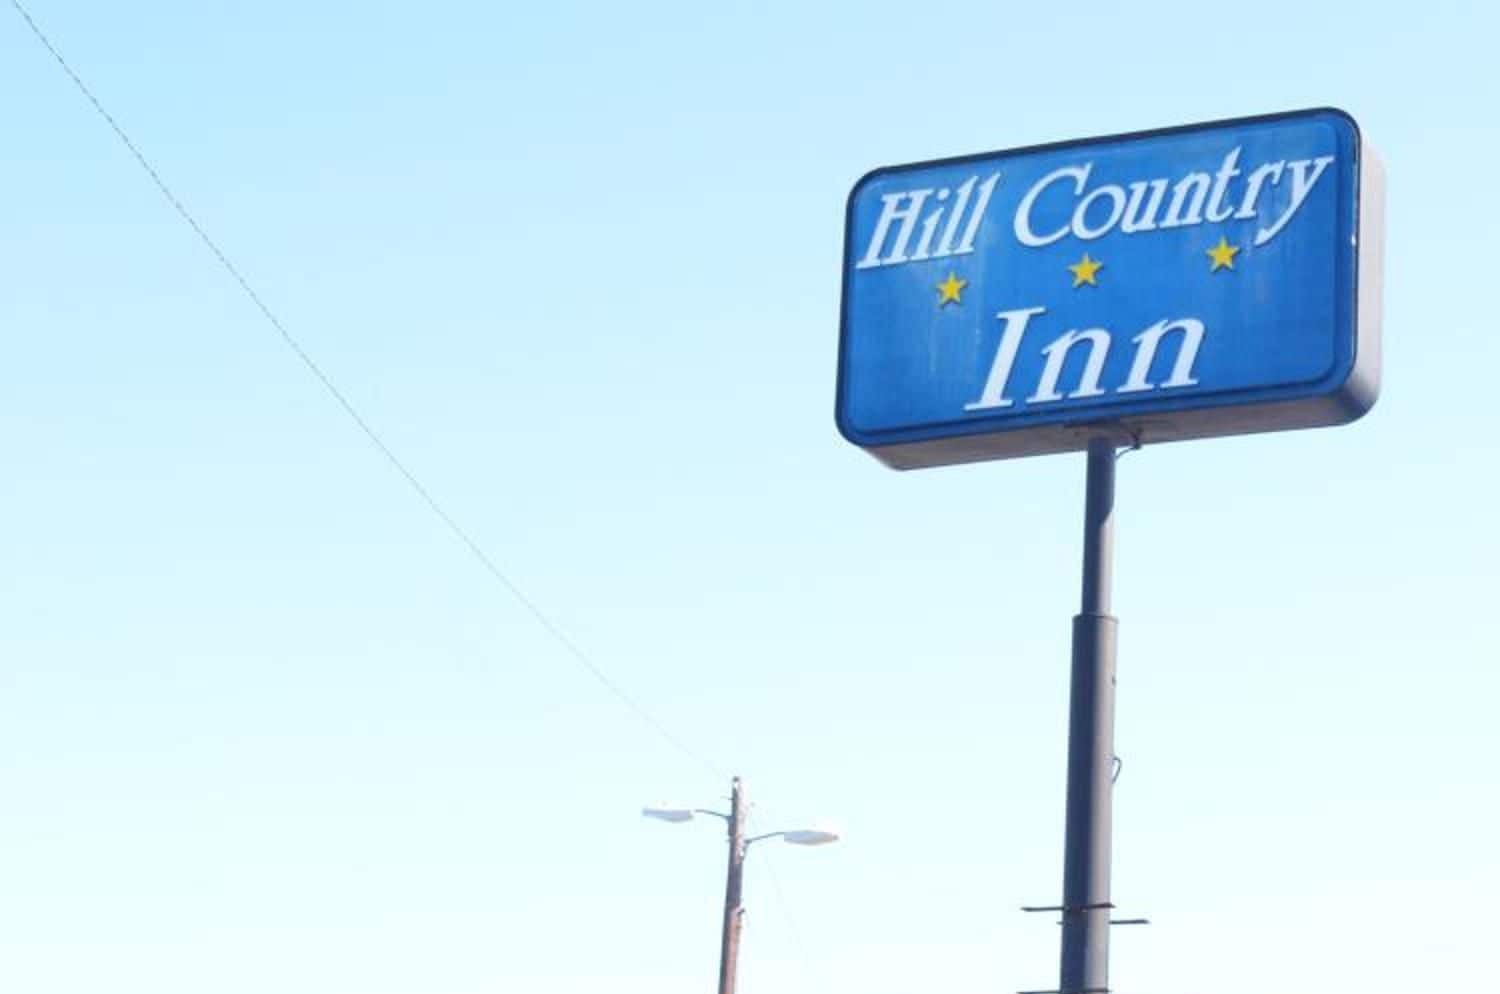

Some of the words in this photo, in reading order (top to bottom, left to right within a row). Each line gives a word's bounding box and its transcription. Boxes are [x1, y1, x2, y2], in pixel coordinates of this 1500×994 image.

[856, 174, 1000, 269] Hill
[1013, 145, 1334, 247] Country
[963, 306, 1206, 412] Inn
